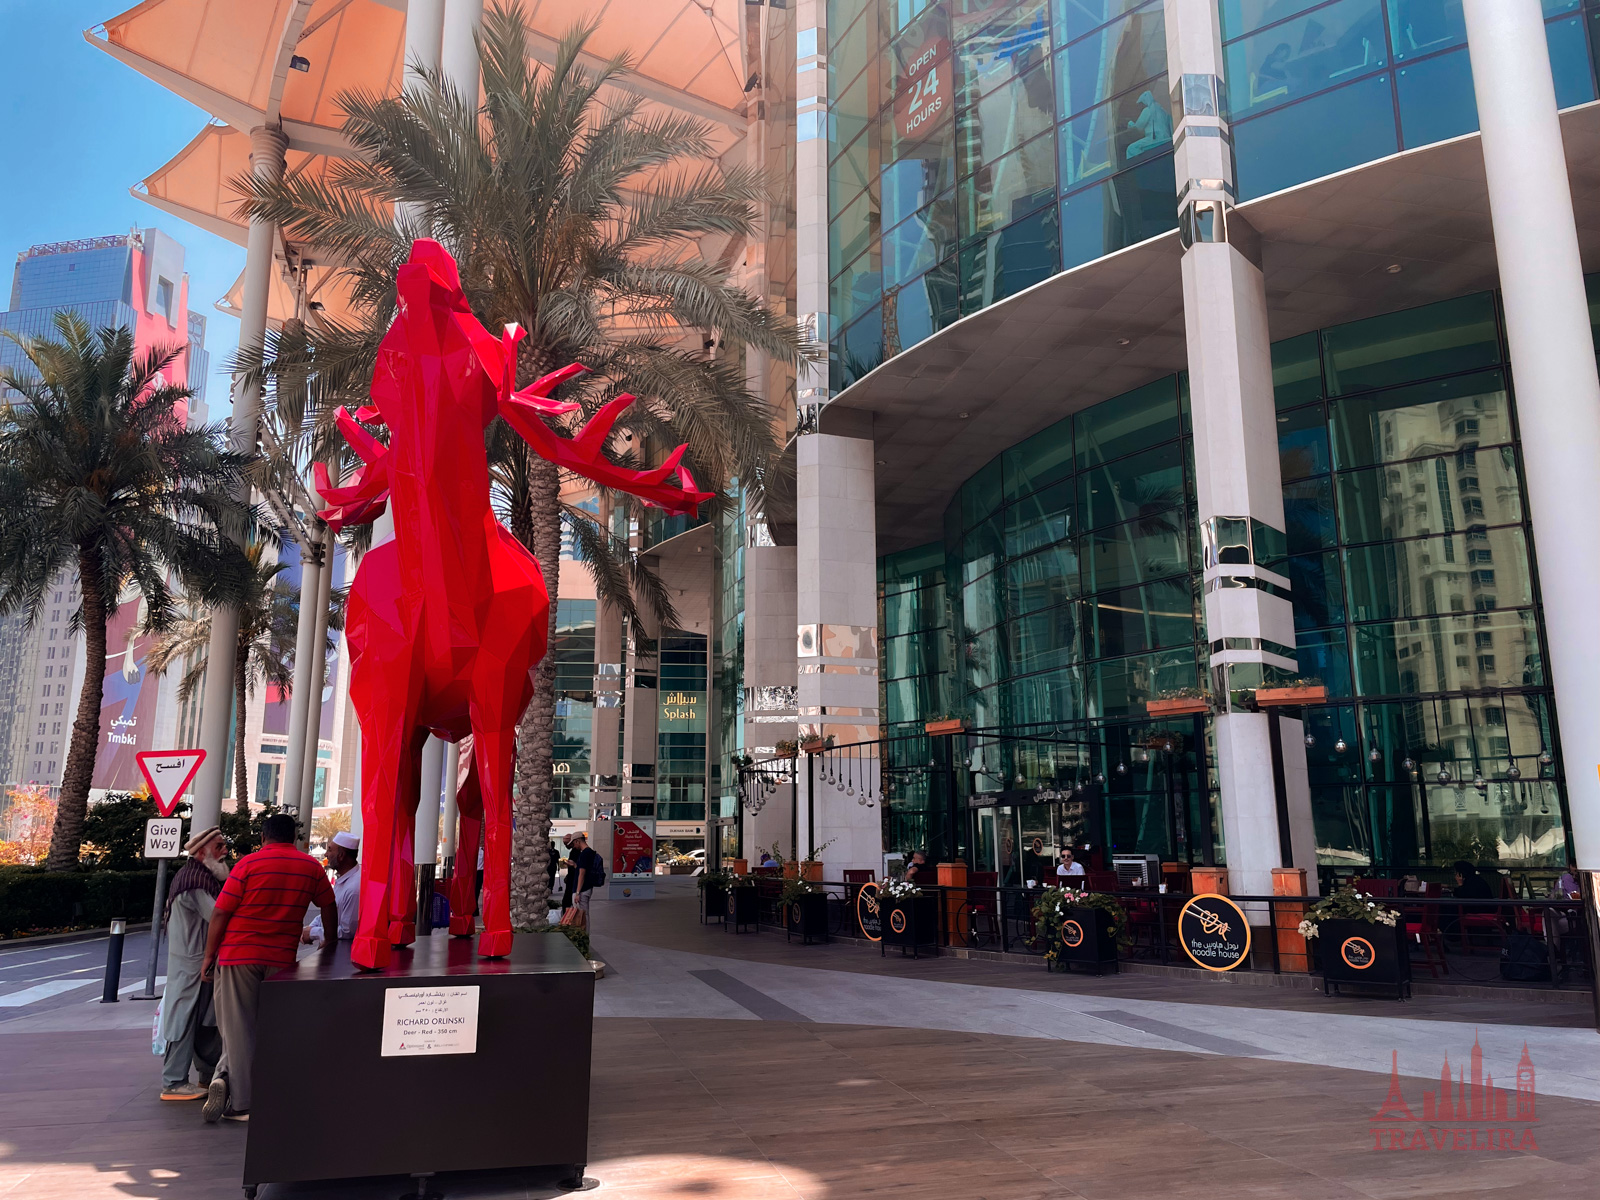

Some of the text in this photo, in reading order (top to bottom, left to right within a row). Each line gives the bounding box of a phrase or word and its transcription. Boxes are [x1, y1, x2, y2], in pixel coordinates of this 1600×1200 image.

[908, 44, 937, 77] OPEN
[908, 67, 939, 115] 24
[906, 96, 942, 134] HOURS
[664, 708, 696, 722] Splash
[110, 715, 137, 729] تمبكي
[107, 732, 137, 745] Tmbki
[155, 758, 185, 773] افسح
[150, 824, 178, 836] Give
[150, 838, 176, 851] Way
[1192, 938, 1202, 948] the
[1192, 948, 1240, 959] noodle house
[397, 1017, 465, 1026] RICHARD ORLINSKI
